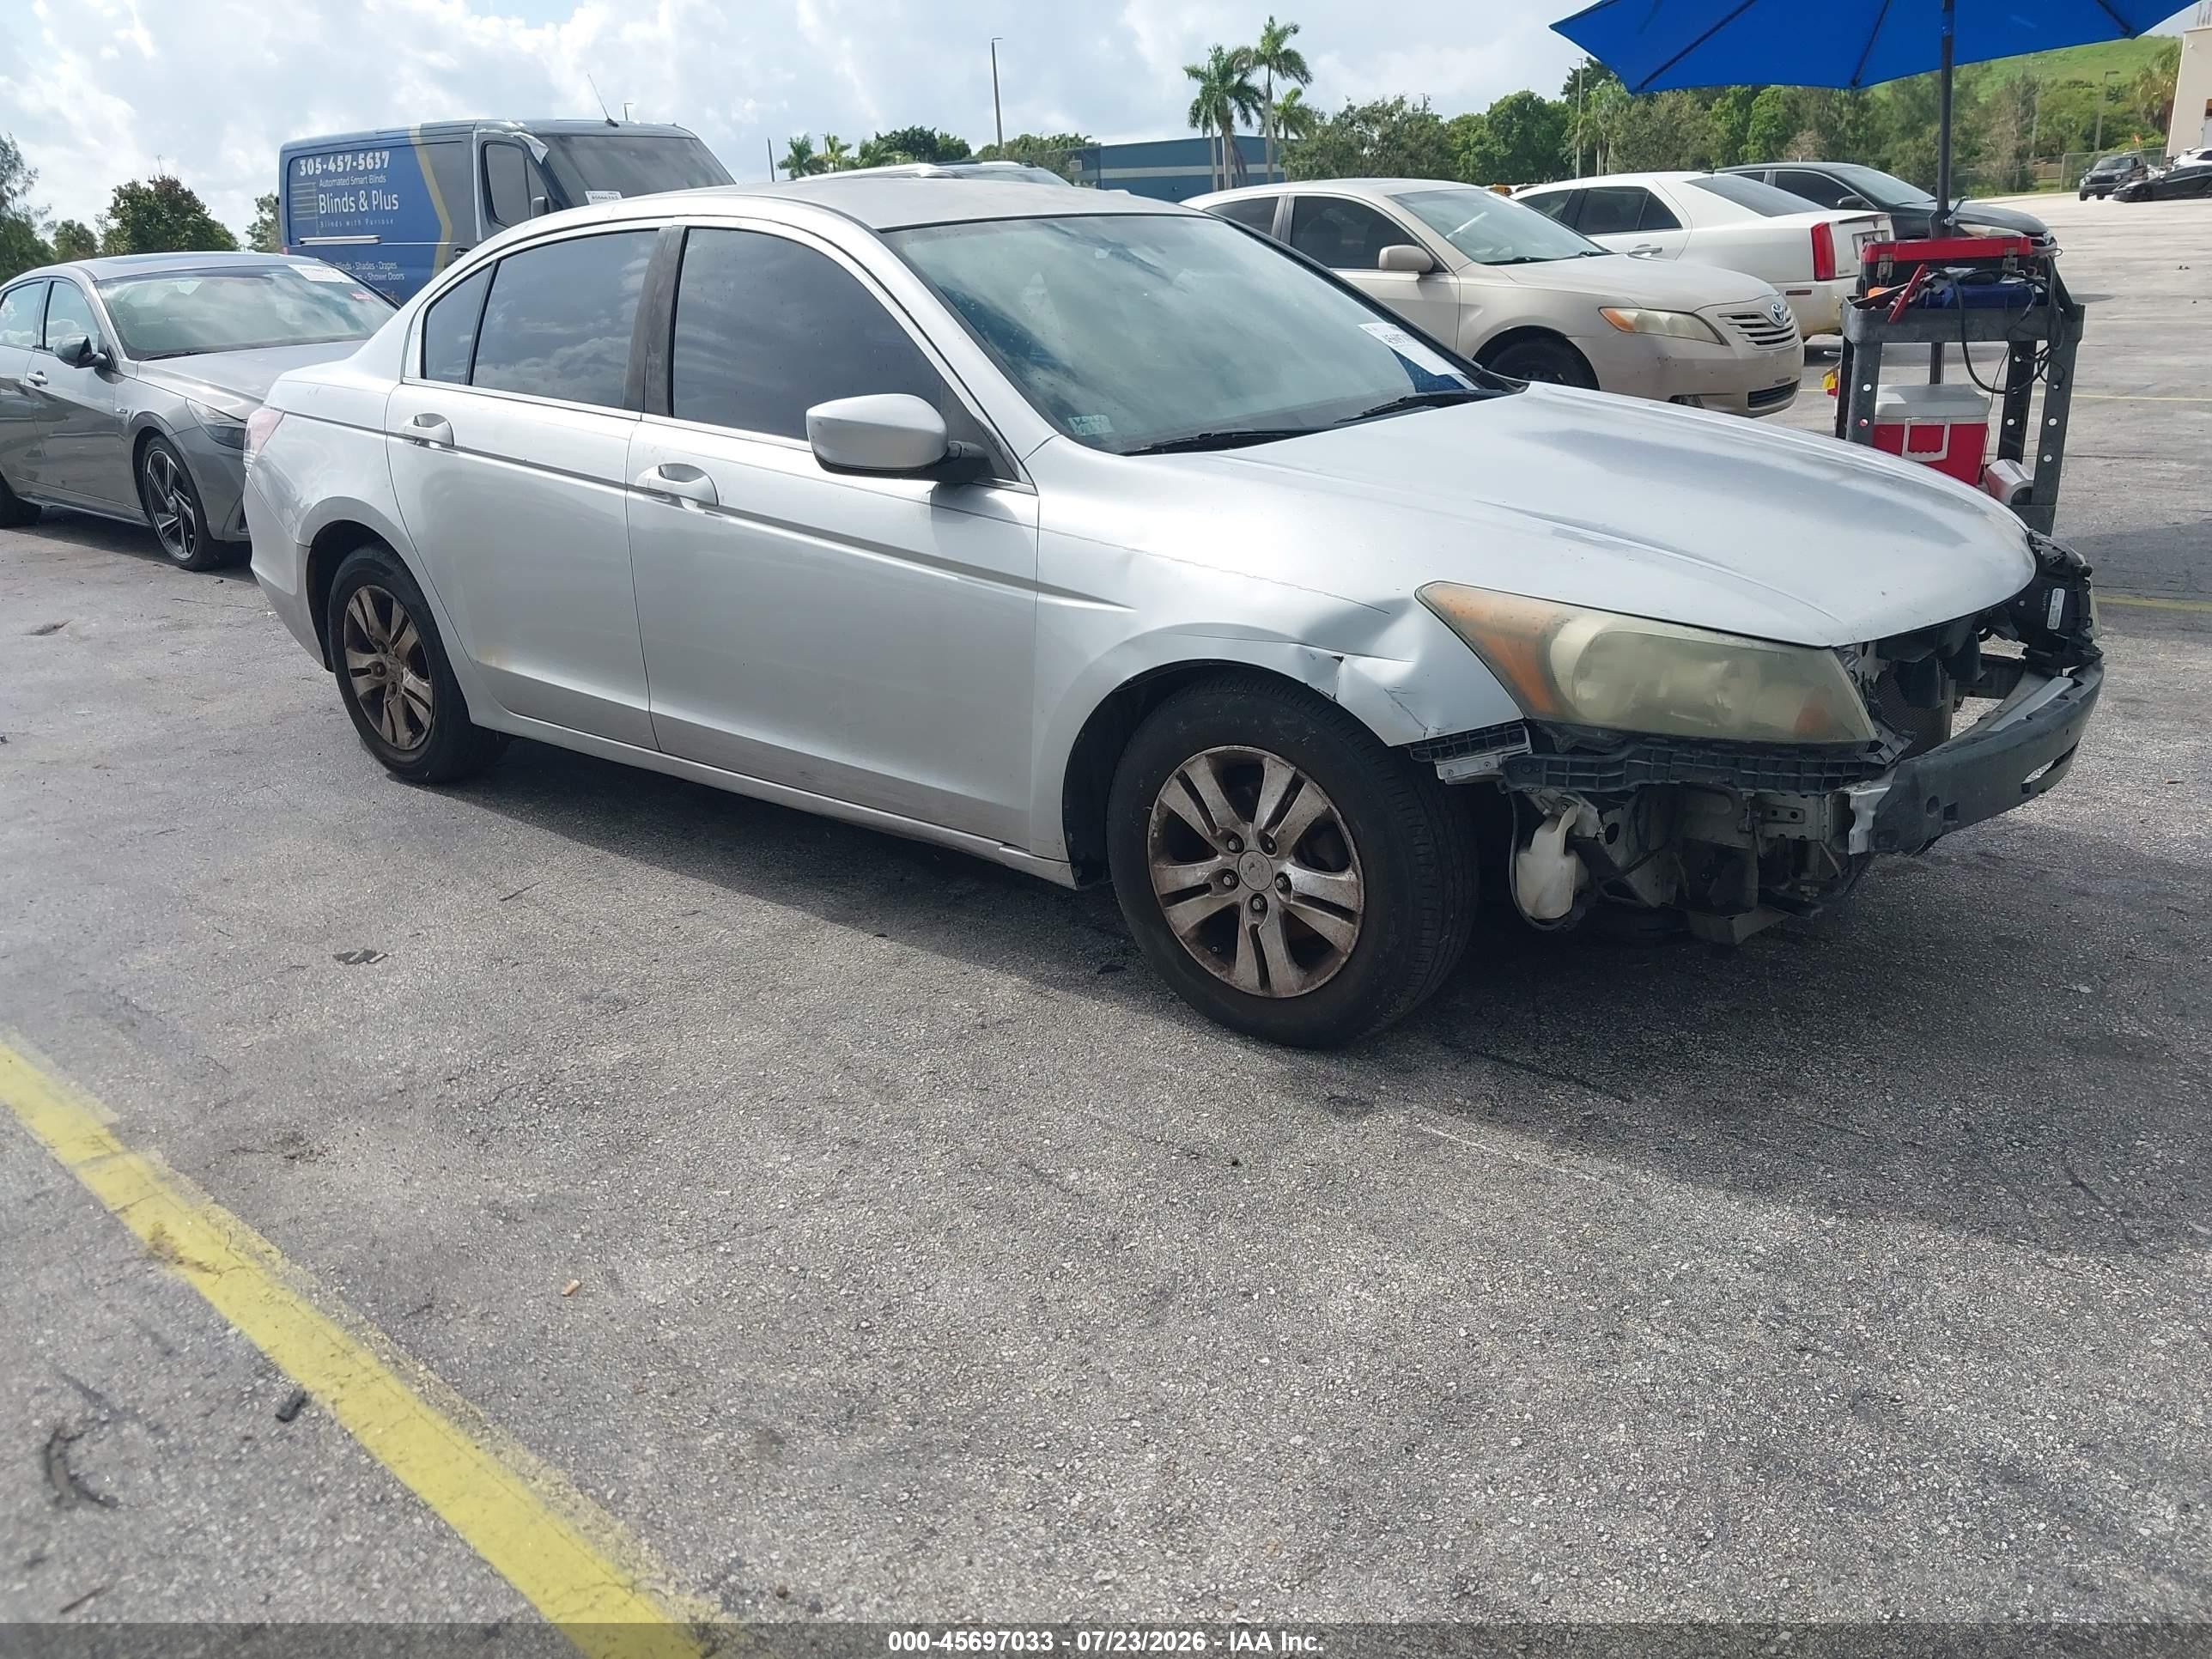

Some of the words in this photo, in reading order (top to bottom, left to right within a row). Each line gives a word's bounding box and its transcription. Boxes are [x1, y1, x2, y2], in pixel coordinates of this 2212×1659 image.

[300, 150, 390, 176] 305-457-5637
[319, 177, 349, 187] Automated
[350, 174, 368, 185] Smart
[368, 173, 386, 184] Blinds
[319, 191, 356, 214] Blinds
[359, 190, 368, 212] &
[371, 189, 399, 211] Plus
